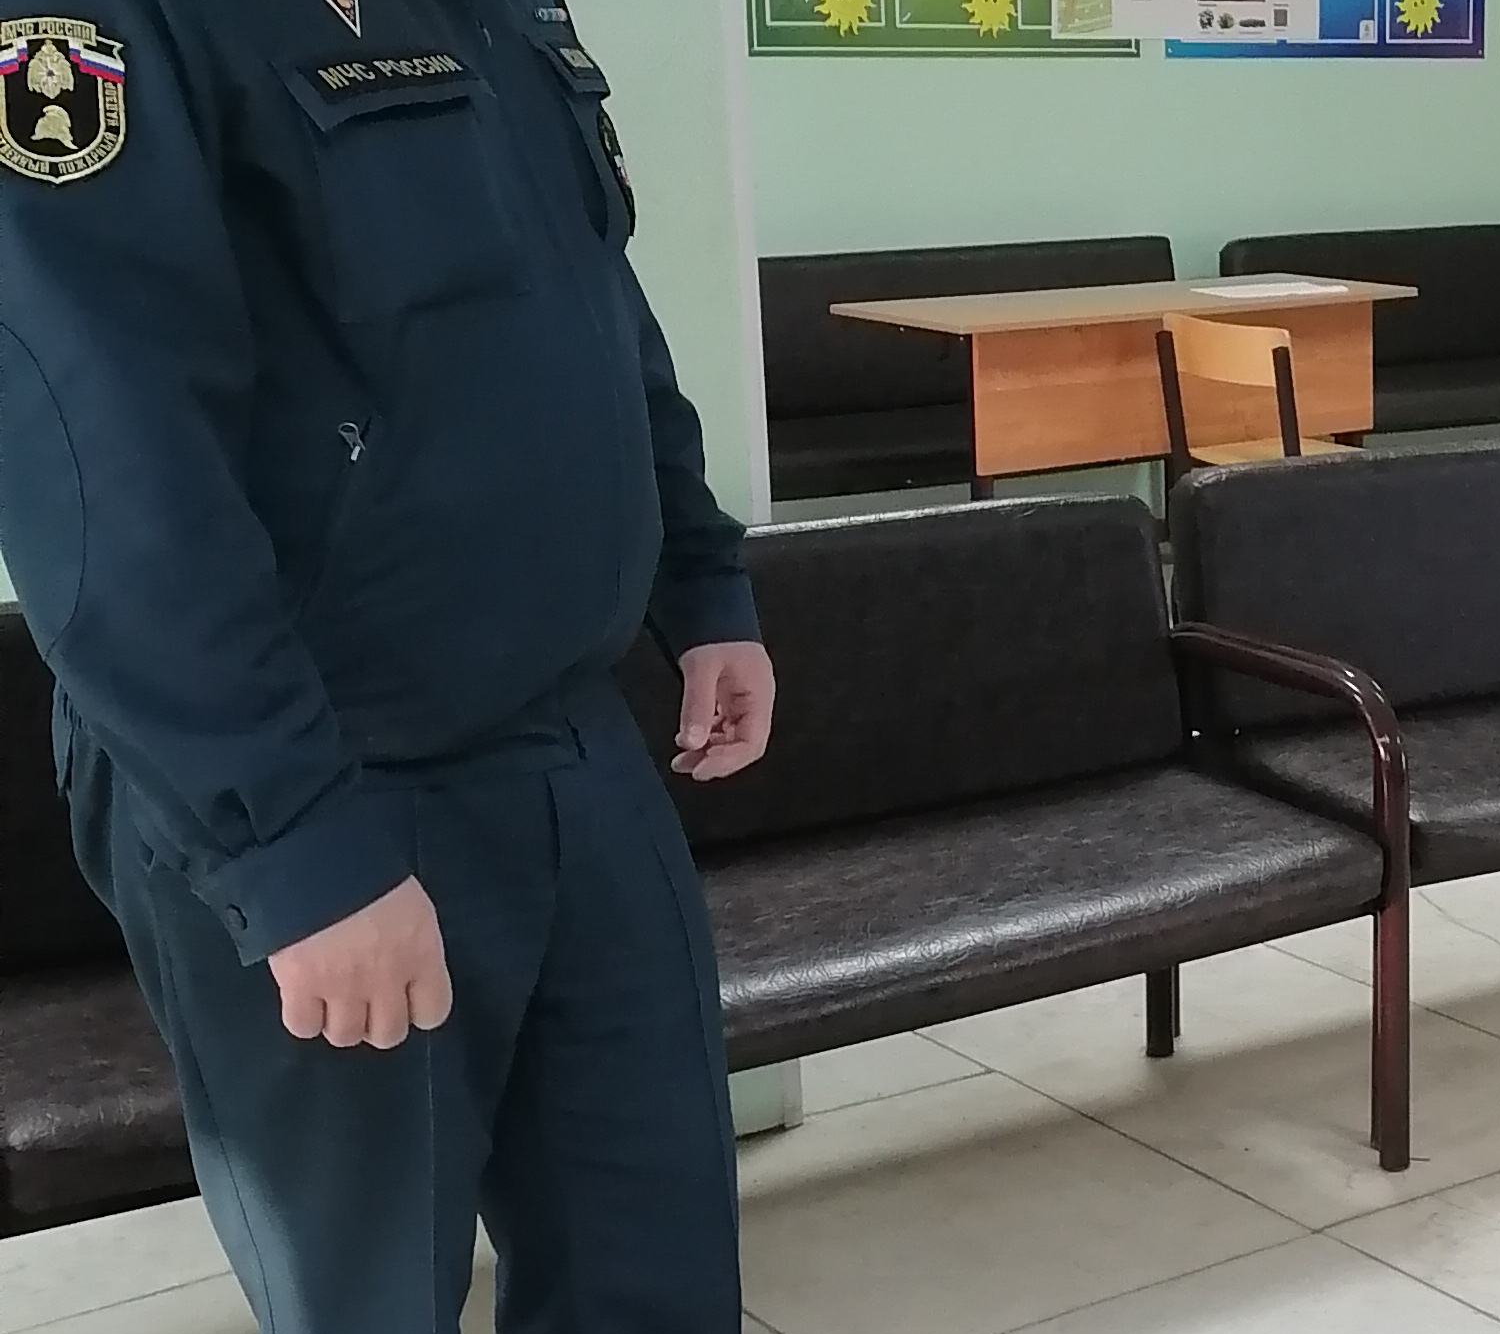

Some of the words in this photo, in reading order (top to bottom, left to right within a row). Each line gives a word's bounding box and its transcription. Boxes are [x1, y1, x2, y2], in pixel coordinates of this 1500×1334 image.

[4, 22, 35, 40] МЧС
[38, 21, 92, 44] РОССИИ
[318, 63, 376, 90] МЧС
[372, 54, 463, 78] РОССИИ
[57, 132, 118, 174] ПОЖАРНЫЙ
